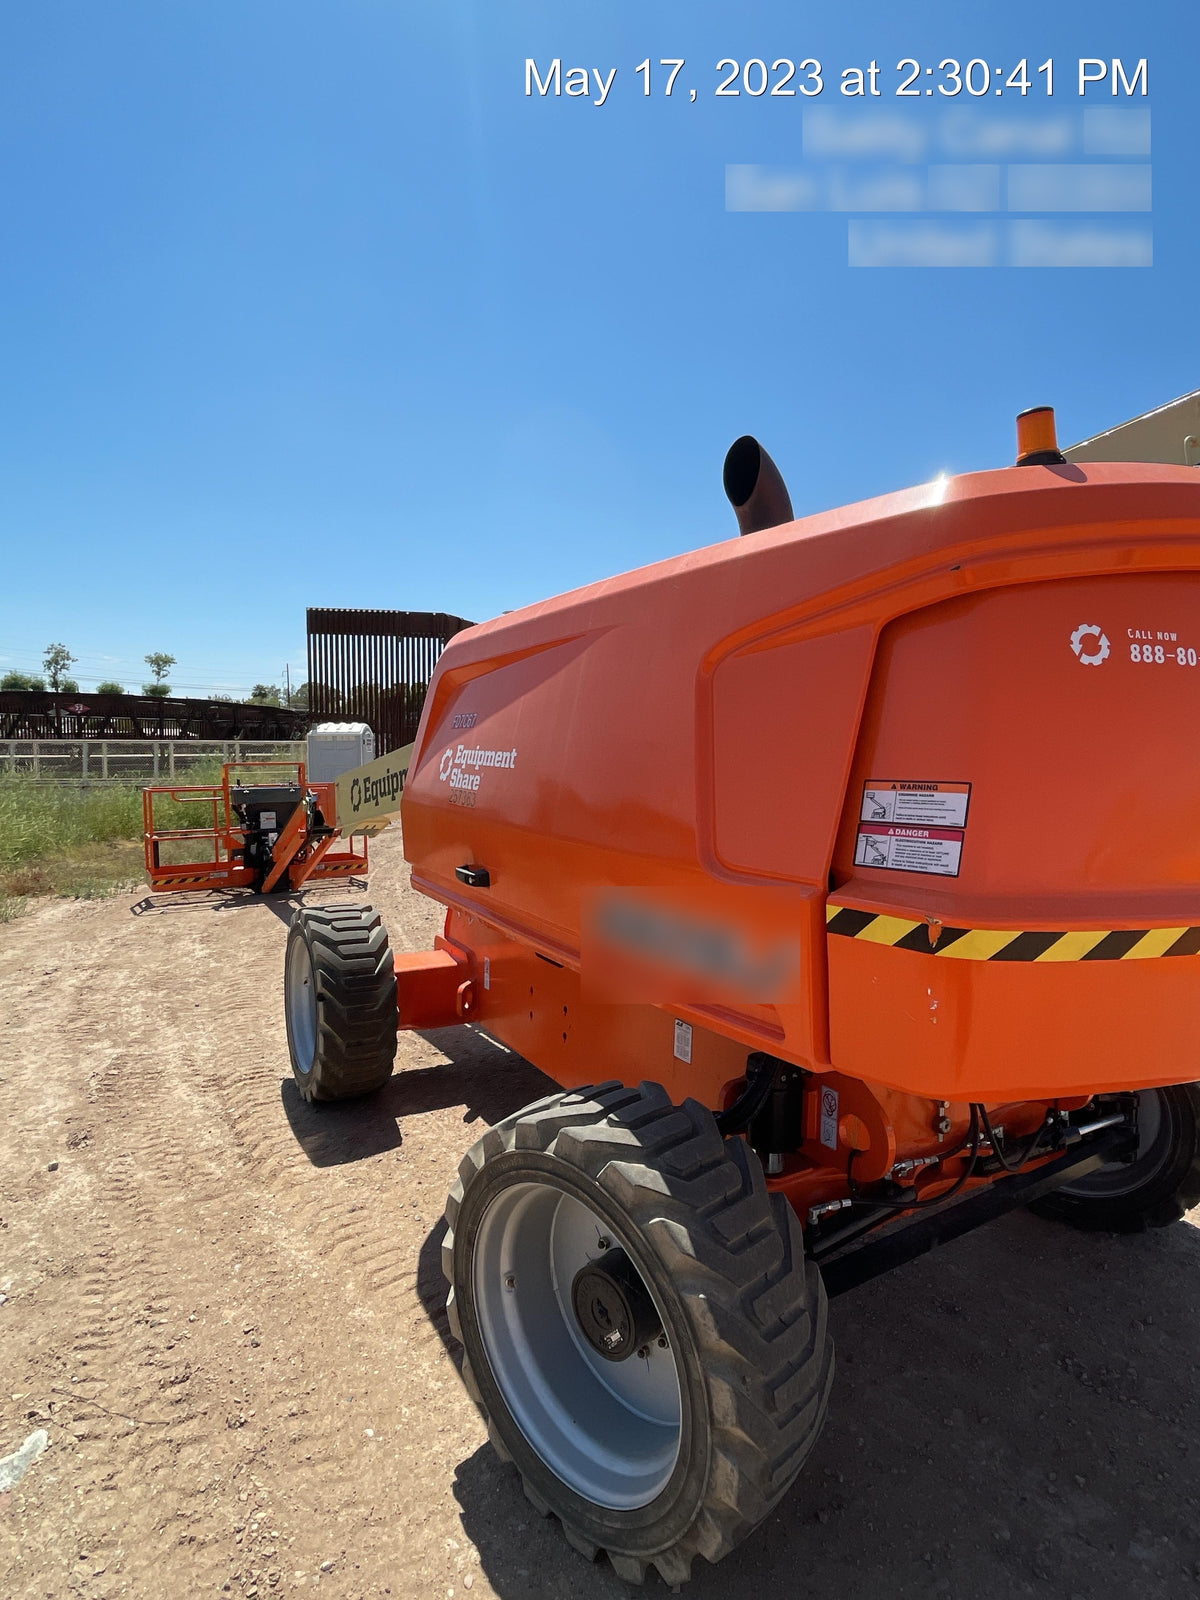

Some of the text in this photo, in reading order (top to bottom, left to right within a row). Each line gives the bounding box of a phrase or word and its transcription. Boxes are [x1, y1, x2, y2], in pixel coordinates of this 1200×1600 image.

[1127, 628, 1177, 642] CALL NOW
[1130, 643, 1200, 666] 888-80
[454, 743, 517, 770] Equipment
[449, 767, 480, 790] Share
[899, 783, 939, 791] WARNING
[895, 828, 929, 837] DANGER
